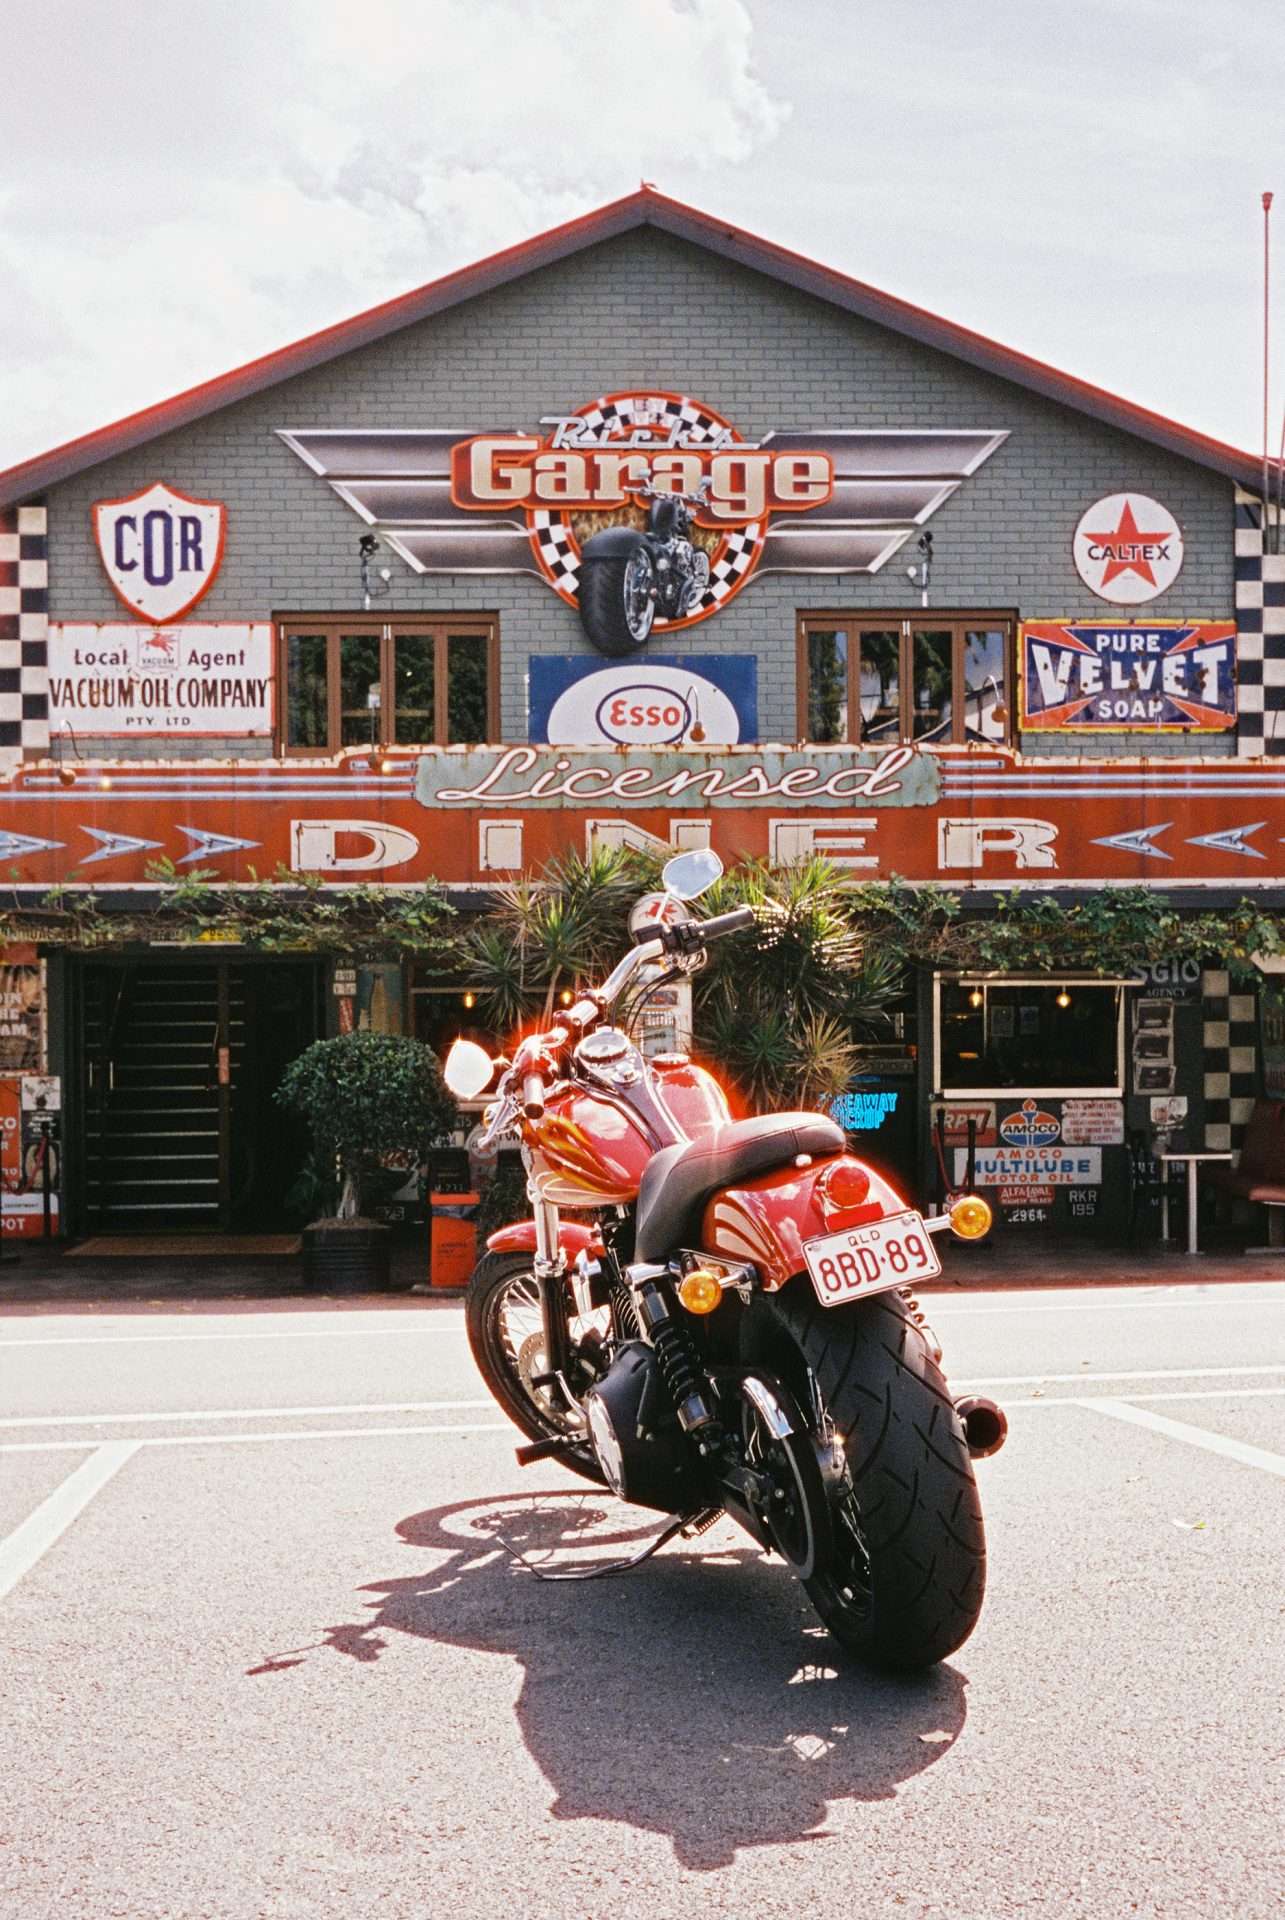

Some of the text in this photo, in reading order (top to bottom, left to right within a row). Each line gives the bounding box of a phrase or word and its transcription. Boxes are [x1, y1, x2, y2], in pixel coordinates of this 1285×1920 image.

[470, 439, 831, 519] Garage
[1087, 545, 1171, 560] CALTEX
[1096, 634, 1161, 652] PURE
[74, 649, 246, 671] Local Agent
[1031, 643, 1228, 706] VELVET
[49, 678, 268, 708] VACUUM OIL COMPANY
[609, 699, 681, 727] Esso
[1098, 700, 1163, 718] SOAP
[125, 717, 191, 726] PTY LTD
[435, 747, 913, 801] Licensed
[290, 817, 1059, 872] DINER
[1146, 988, 1187, 998] AGENCY
[944, 1114, 986, 1125] RPM
[1002, 1124, 1059, 1134] AMOCO
[996, 1150, 1062, 1159] AMOCO
[985, 1174, 1073, 1183] MOTOR OIL
[1068, 1190, 1097, 1203] RKR
[1072, 1203, 1095, 1216] 195
[847, 1230, 881, 1247] QLD
